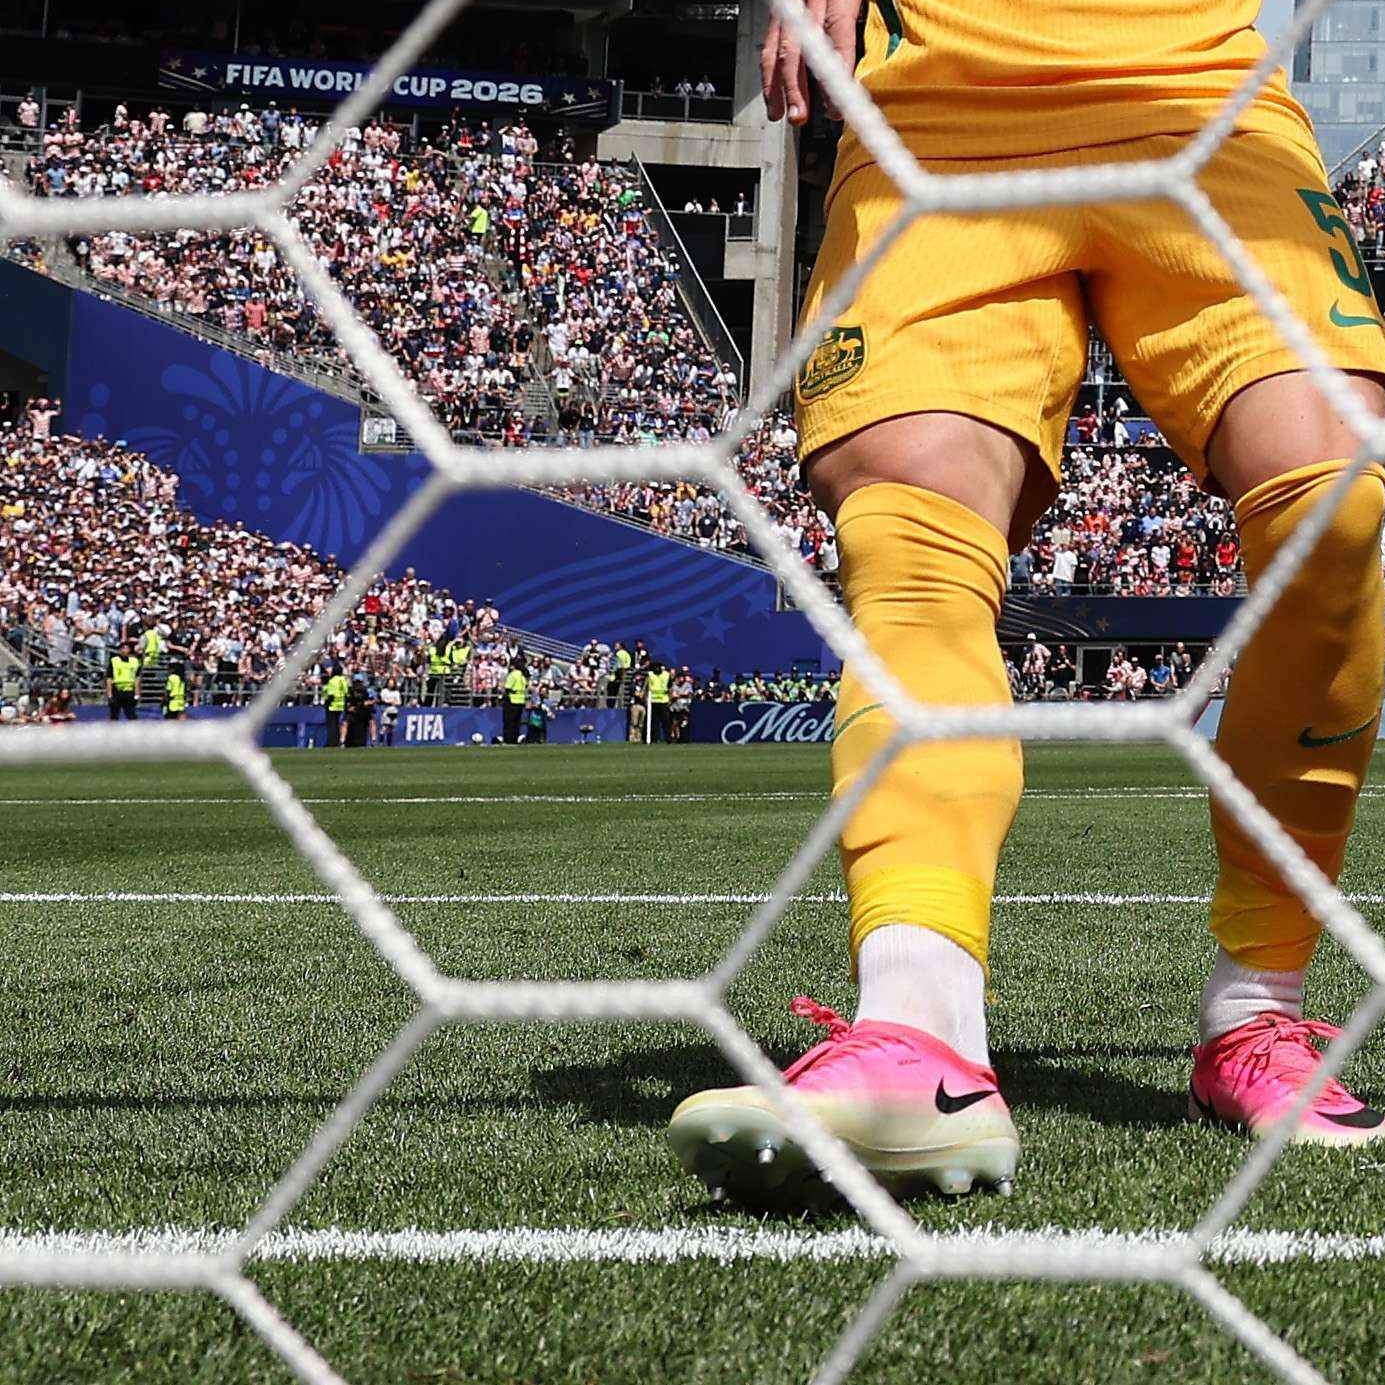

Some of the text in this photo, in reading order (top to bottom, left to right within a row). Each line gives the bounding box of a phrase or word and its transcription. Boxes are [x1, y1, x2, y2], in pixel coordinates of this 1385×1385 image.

[225, 63, 285, 89] FIFA
[393, 74, 447, 98] CUP
[450, 78, 544, 105] 2026
[1296, 187, 1371, 298] 5
